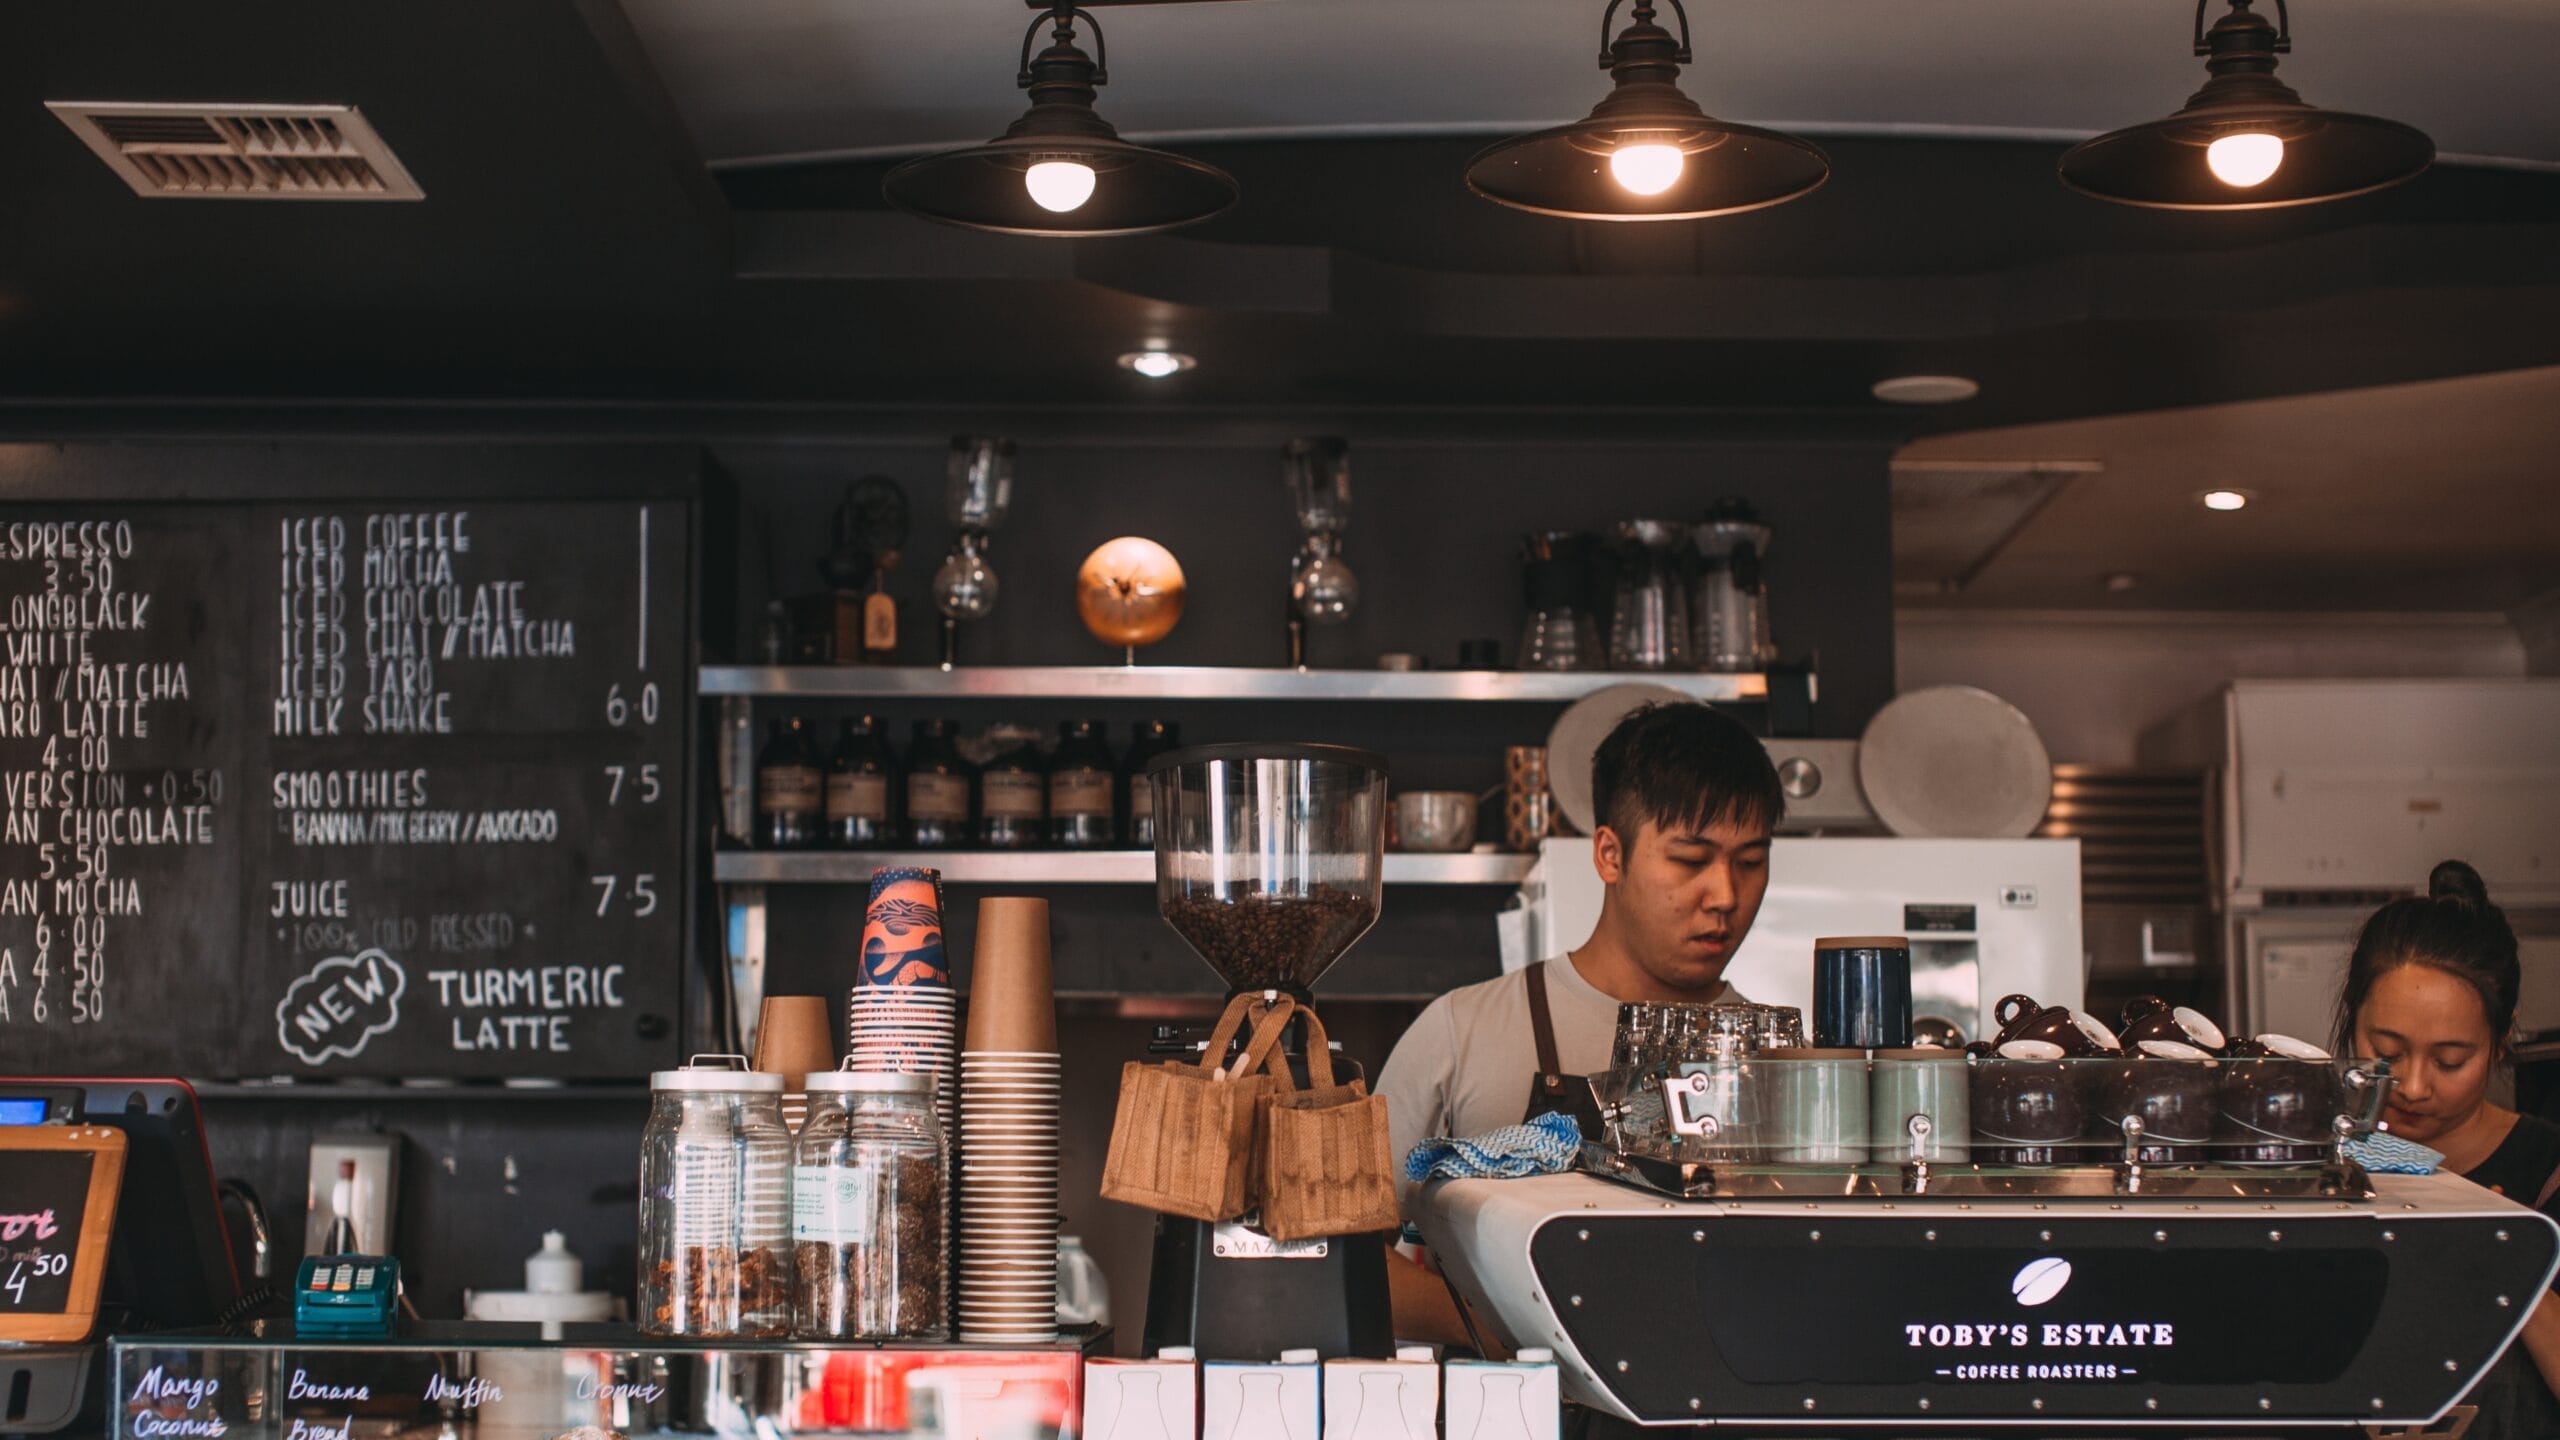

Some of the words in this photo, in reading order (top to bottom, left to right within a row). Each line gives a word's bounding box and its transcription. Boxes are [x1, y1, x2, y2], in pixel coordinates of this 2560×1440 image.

[281, 516, 346, 556] ICED
[366, 511, 470, 553] COFFEE
[281, 552, 346, 591] ICED
[363, 549, 455, 589] MOCHA
[281, 588, 346, 628] ICED
[363, 581, 526, 627] CHOCOLATE
[7, 631, 94, 667] WHITE
[281, 623, 346, 663] ICED
[281, 659, 346, 699] ICED
[367, 657, 434, 697] TARO
[63, 699, 149, 738] LATTE
[274, 697, 345, 737] MILK
[363, 692, 452, 734] SHAKE
[5, 771, 125, 809] VERSION
[273, 769, 428, 809] SMOOTHIES
[60, 806, 213, 845] CHOCOLATE
[55, 878, 142, 917] MOCHA
[271, 880, 348, 919] JUICE
[296, 958, 386, 1042] NEW
[427, 964, 625, 1009] TURMERIC
[452, 1015, 571, 1052] LATTE
[2041, 1324, 2174, 1347] ESTATE
[133, 1365, 219, 1410] Mango
[423, 1373, 504, 1409] Muffin
[1956, 1365, 2020, 1379] COFFEE
[2027, 1364, 2117, 1379] ROASTERS
[134, 1408, 228, 1438] Coconut
